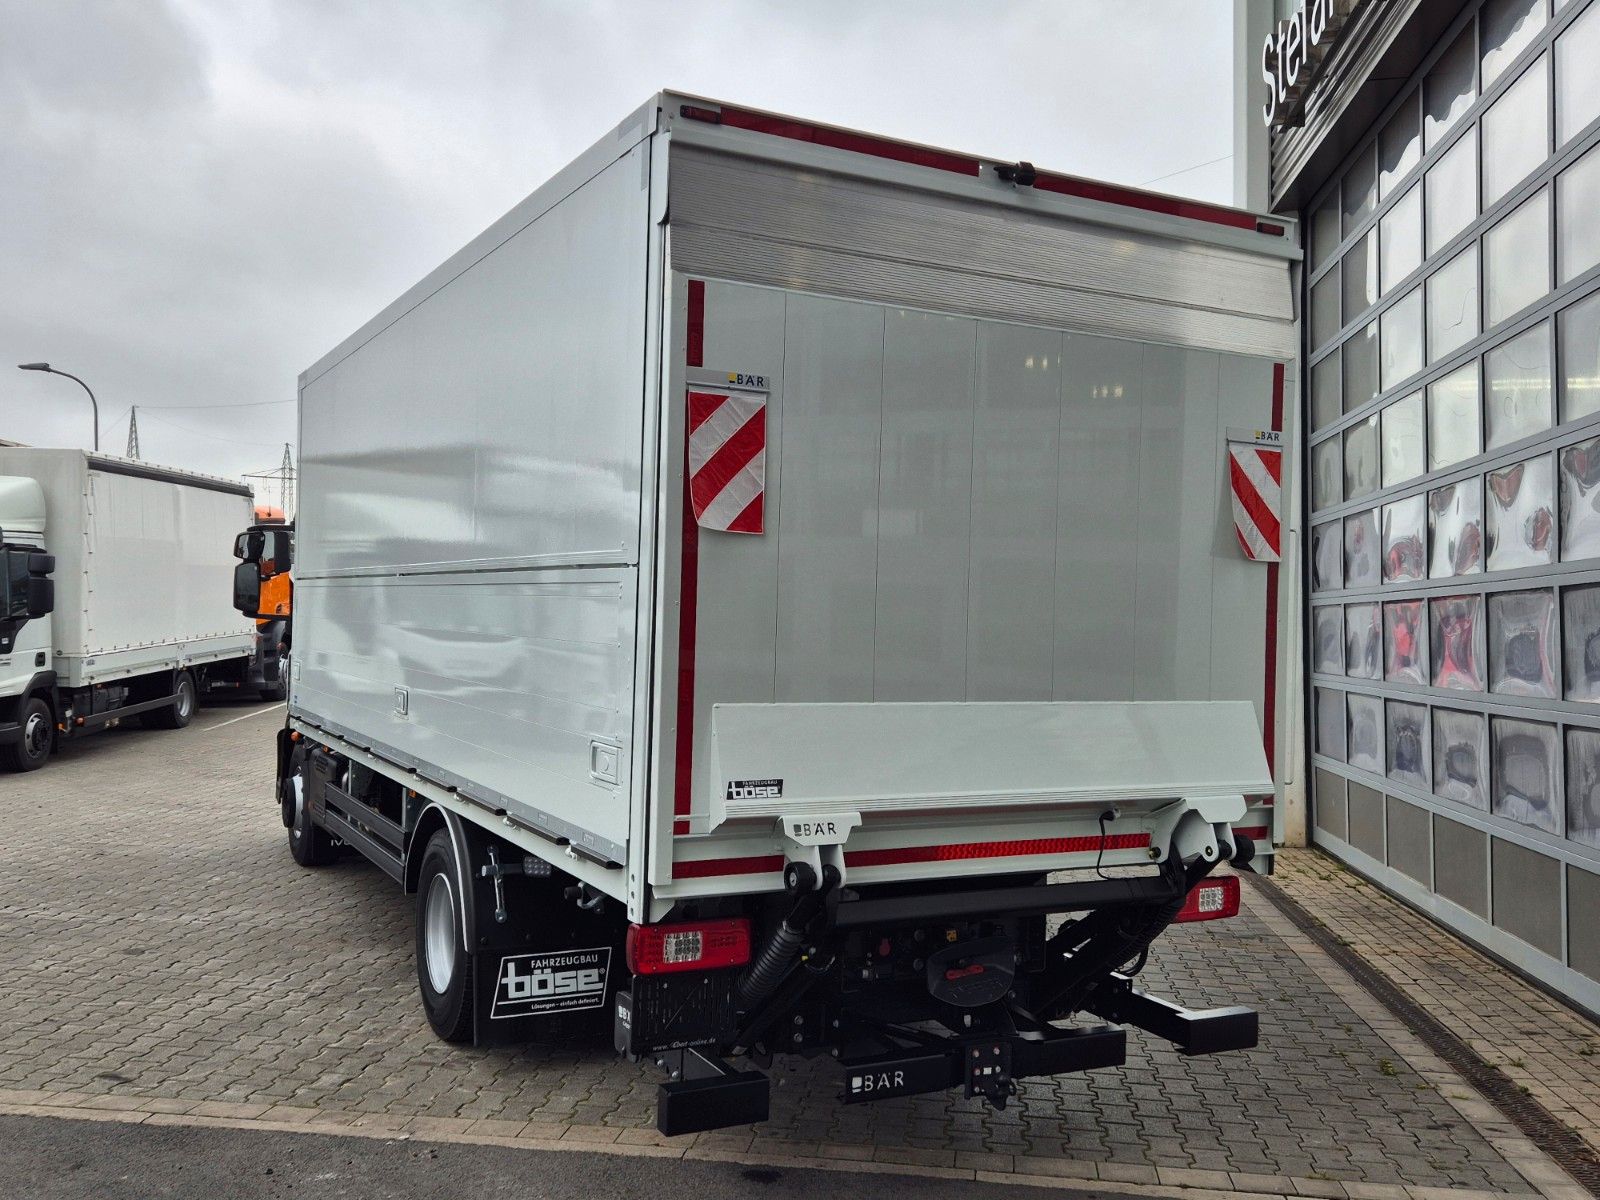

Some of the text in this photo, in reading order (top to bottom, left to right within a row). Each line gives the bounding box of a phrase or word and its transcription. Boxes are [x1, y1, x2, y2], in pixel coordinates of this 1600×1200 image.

[737, 373, 764, 387] BÄR
[1261, 431, 1280, 441] BÄR
[803, 822, 837, 836] BÄR
[531, 954, 598, 969] FAHRZEUGBAU
[864, 1071, 904, 1092] BÄR
